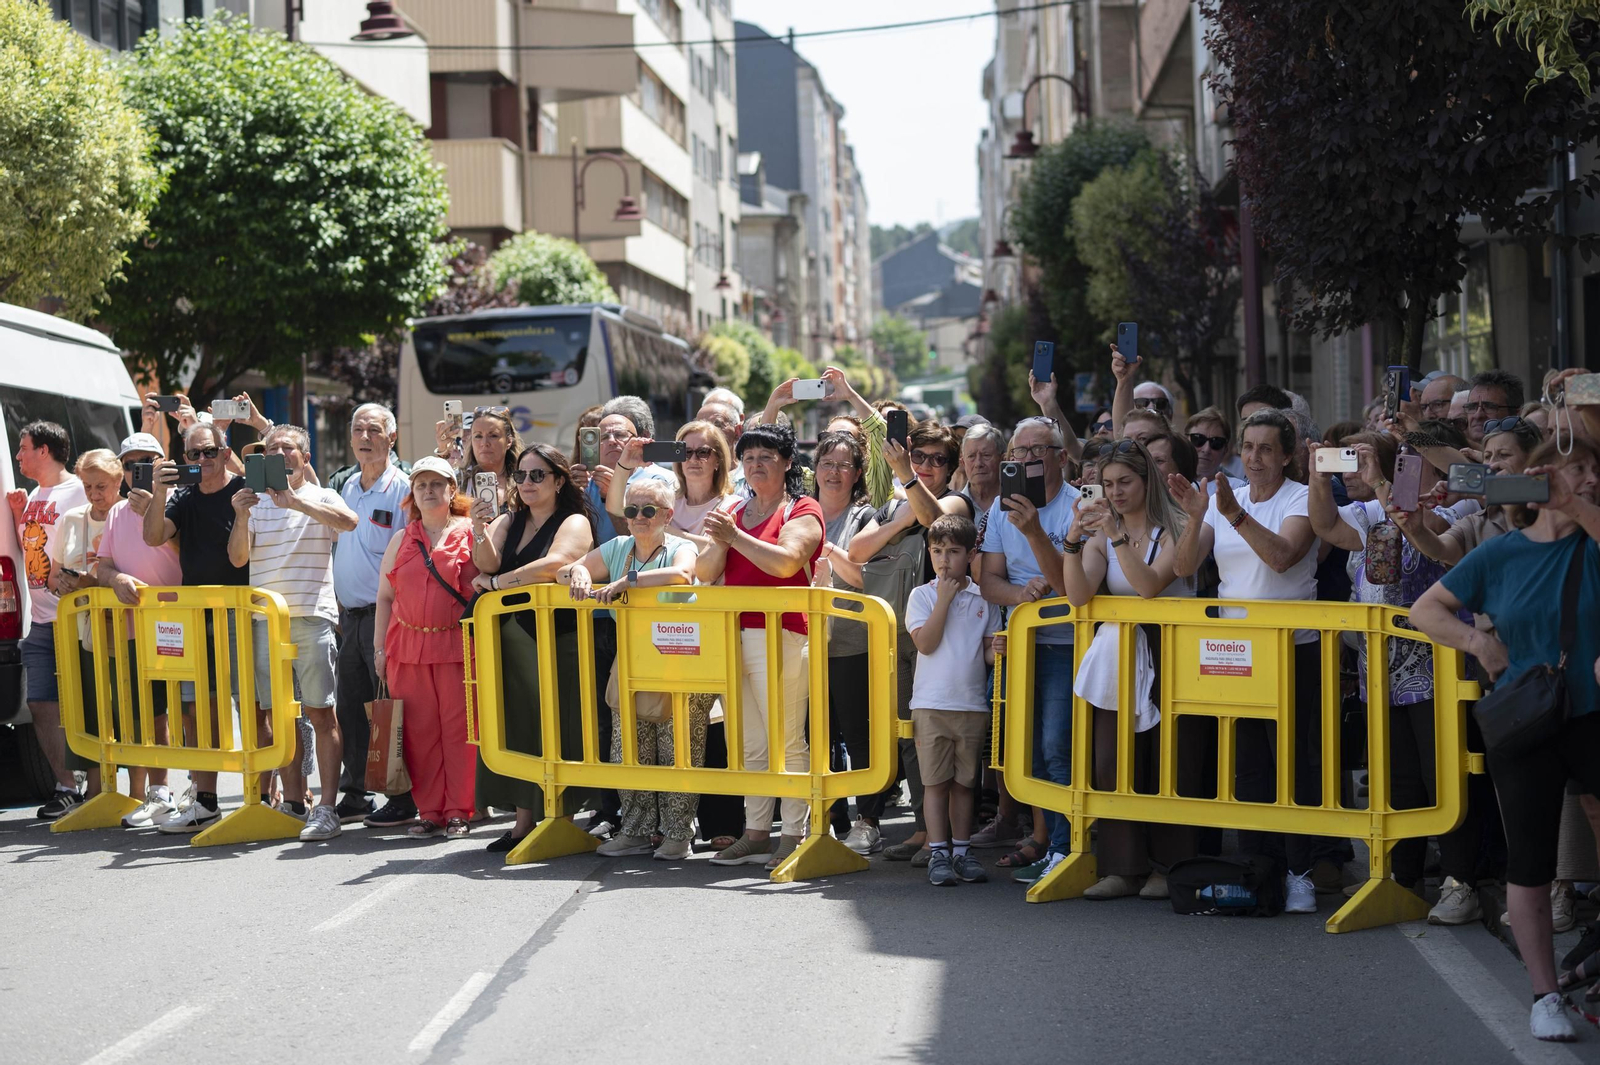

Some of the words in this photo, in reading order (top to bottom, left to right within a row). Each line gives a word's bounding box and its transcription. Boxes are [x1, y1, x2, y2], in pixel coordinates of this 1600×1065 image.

[27, 500, 49, 512] AVE
[45, 501, 57, 513] A
[20, 512, 37, 524] ICE
[37, 511, 60, 525] DAY
[158, 623, 182, 635] torneiro
[657, 623, 694, 634] torneiro
[1206, 640, 1246, 653] torneiro
